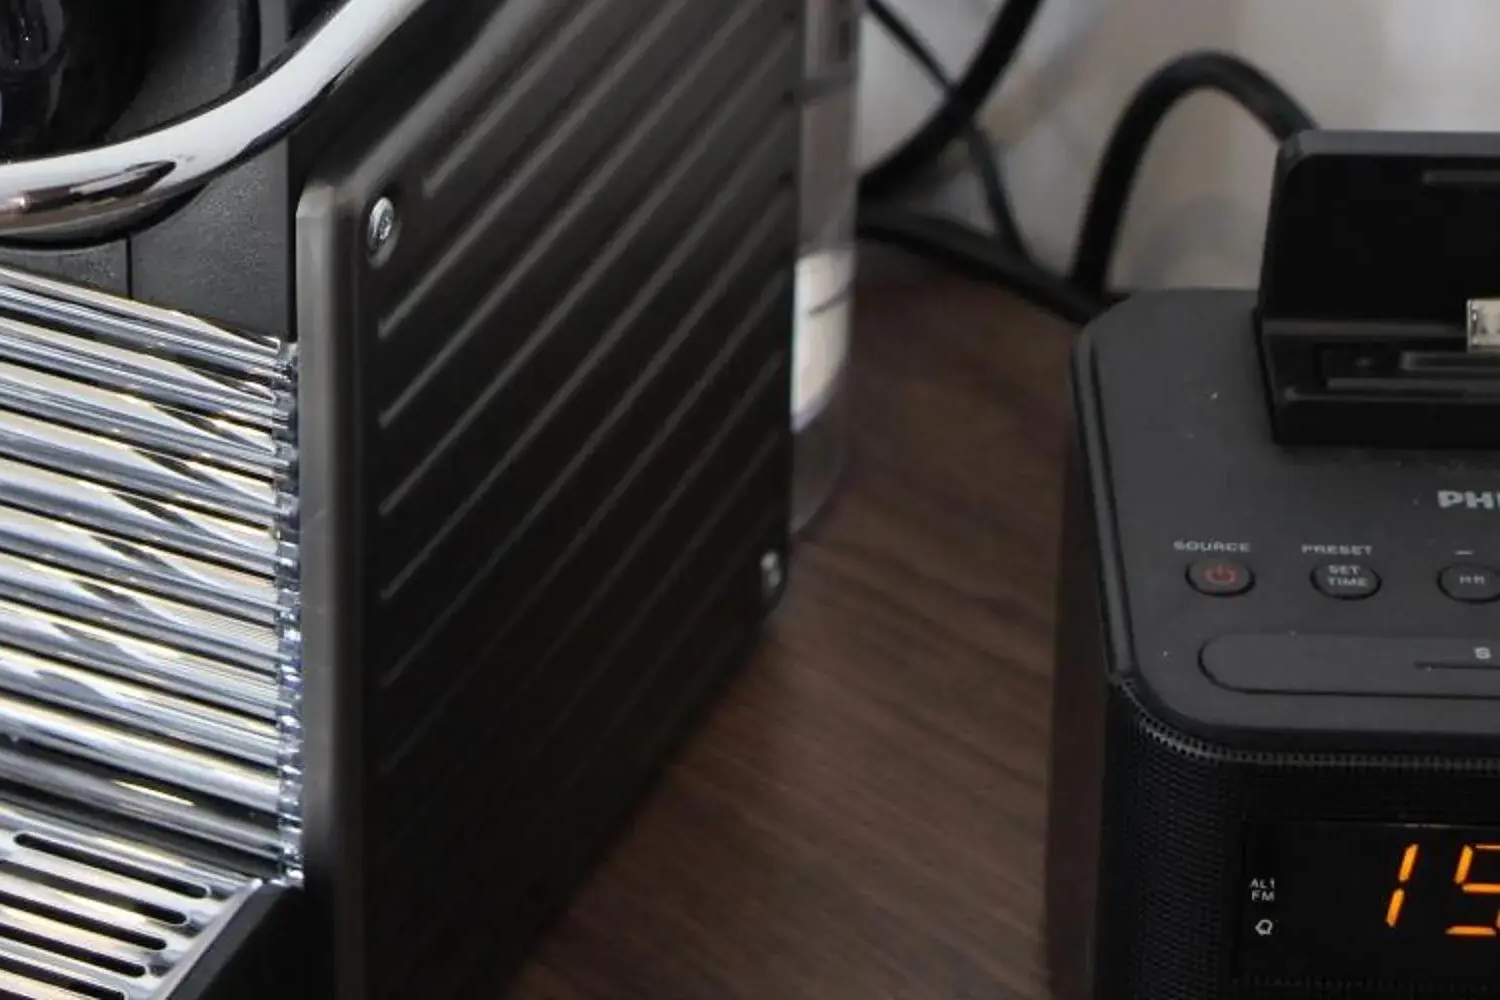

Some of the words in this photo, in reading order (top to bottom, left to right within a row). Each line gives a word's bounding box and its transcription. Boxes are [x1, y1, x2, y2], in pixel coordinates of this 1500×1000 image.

[1173, 540, 1251, 553] SOURCE
[1301, 544, 1373, 556] PRESET
[1328, 564, 1359, 576] SET
[1328, 575, 1368, 588] TIME
[1251, 889, 1275, 902] FM
